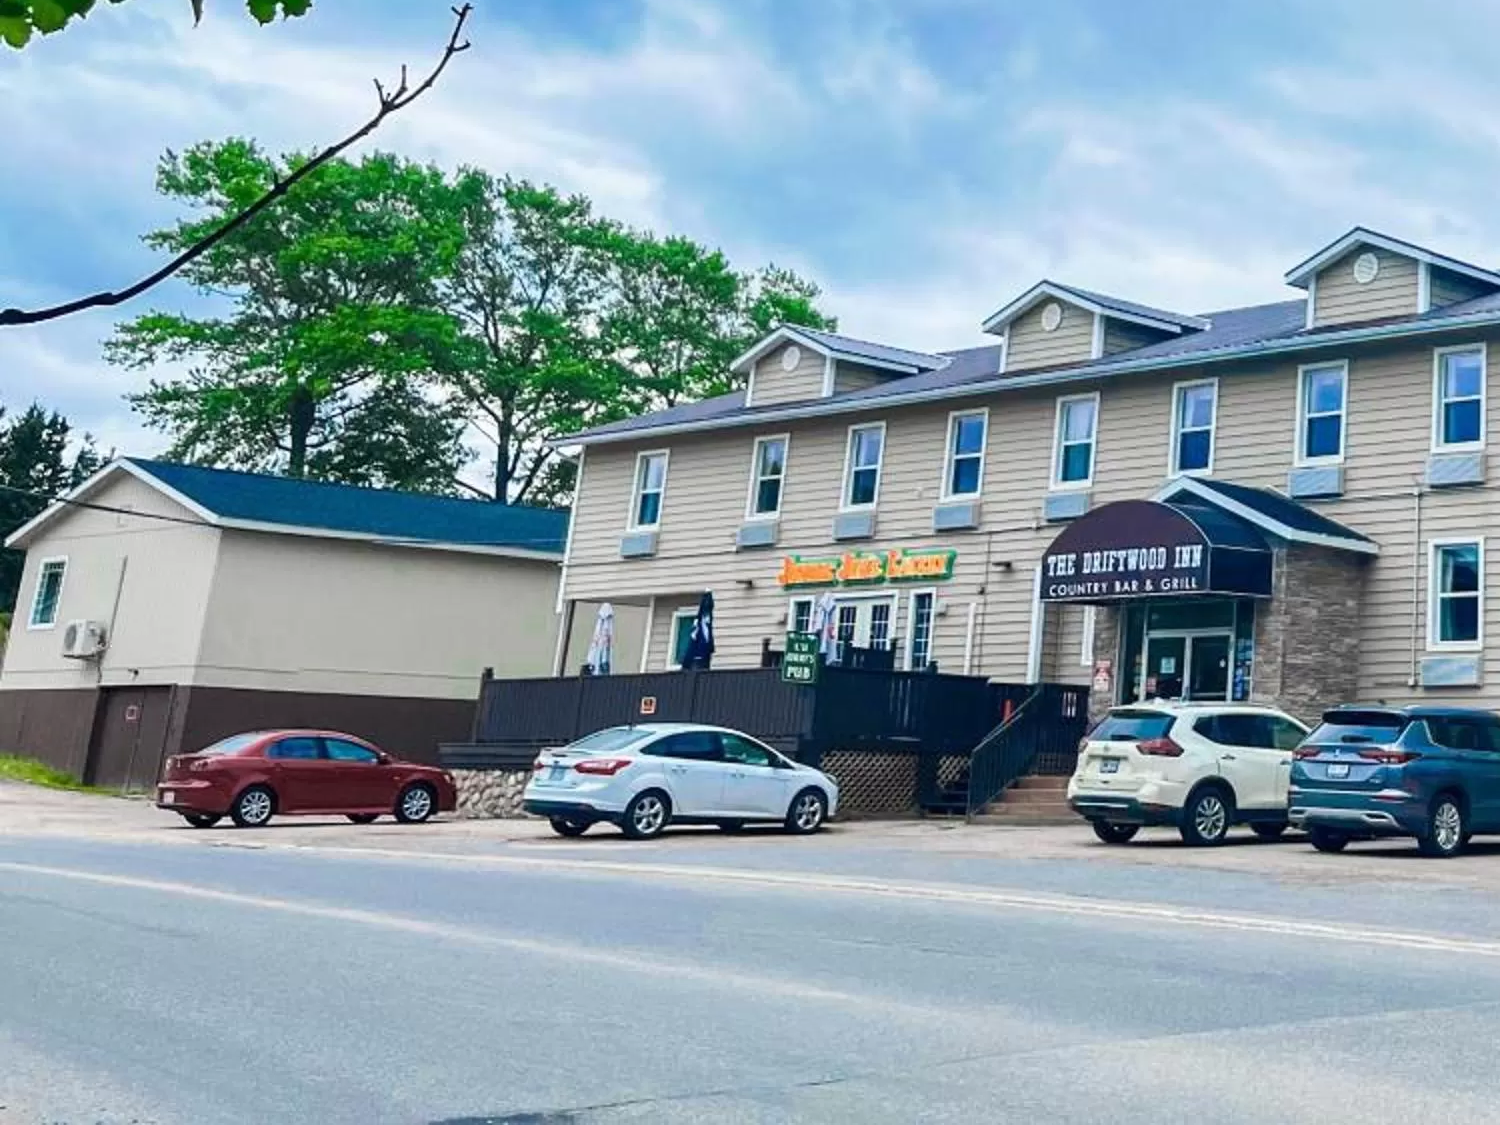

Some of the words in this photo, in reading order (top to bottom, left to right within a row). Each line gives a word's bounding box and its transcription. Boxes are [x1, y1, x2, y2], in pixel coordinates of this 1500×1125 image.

[1048, 554, 1075, 576] THE
[1082, 547, 1165, 574] DRIFTWOOD
[1174, 545, 1203, 568] INN
[1049, 582, 1107, 596] COUNTRY
[1115, 579, 1138, 593] BAR
[1144, 578, 1153, 591] &
[1161, 576, 1197, 591] GRILL
